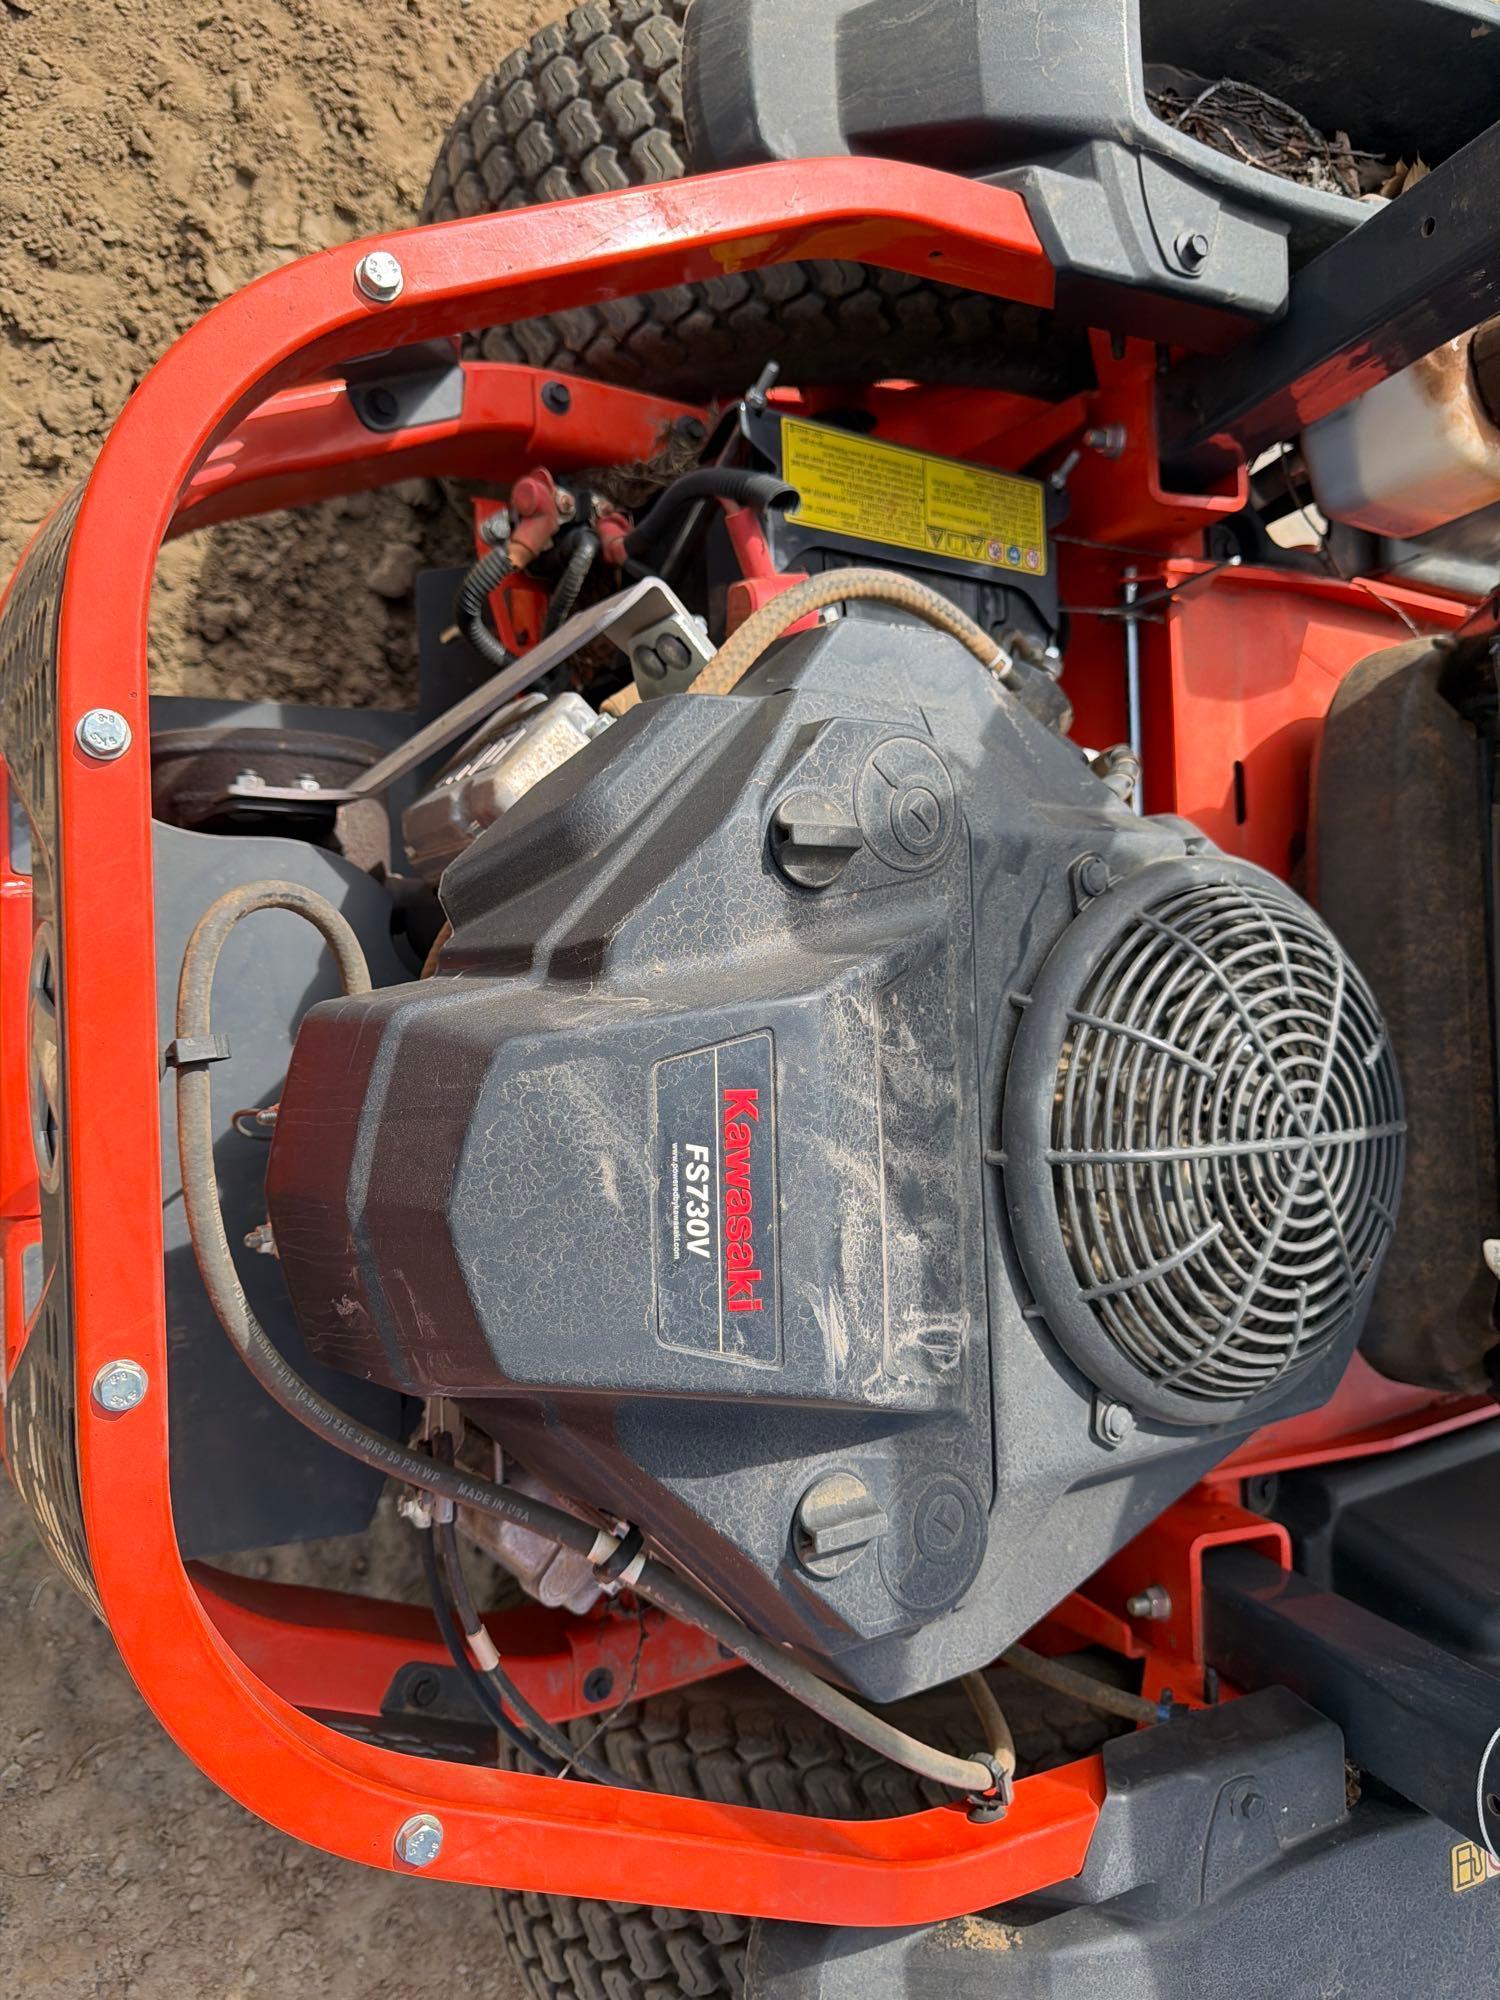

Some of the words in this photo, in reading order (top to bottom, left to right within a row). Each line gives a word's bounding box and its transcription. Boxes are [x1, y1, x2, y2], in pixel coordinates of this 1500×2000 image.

[671, 1141, 680, 1260] www.poweredbykawasaki.com
[685, 1142, 711, 1259] FS730V
[723, 1087, 764, 1312] Kawasaki
[333, 1419, 356, 1440] SAE
[387, 1450, 401, 1464] 50
[400, 1458, 421, 1476] PSI
[421, 1466, 441, 1482] WP
[457, 1482, 492, 1505] MADE
[490, 1499, 505, 1512] IN
[507, 1503, 530, 1521] USA
